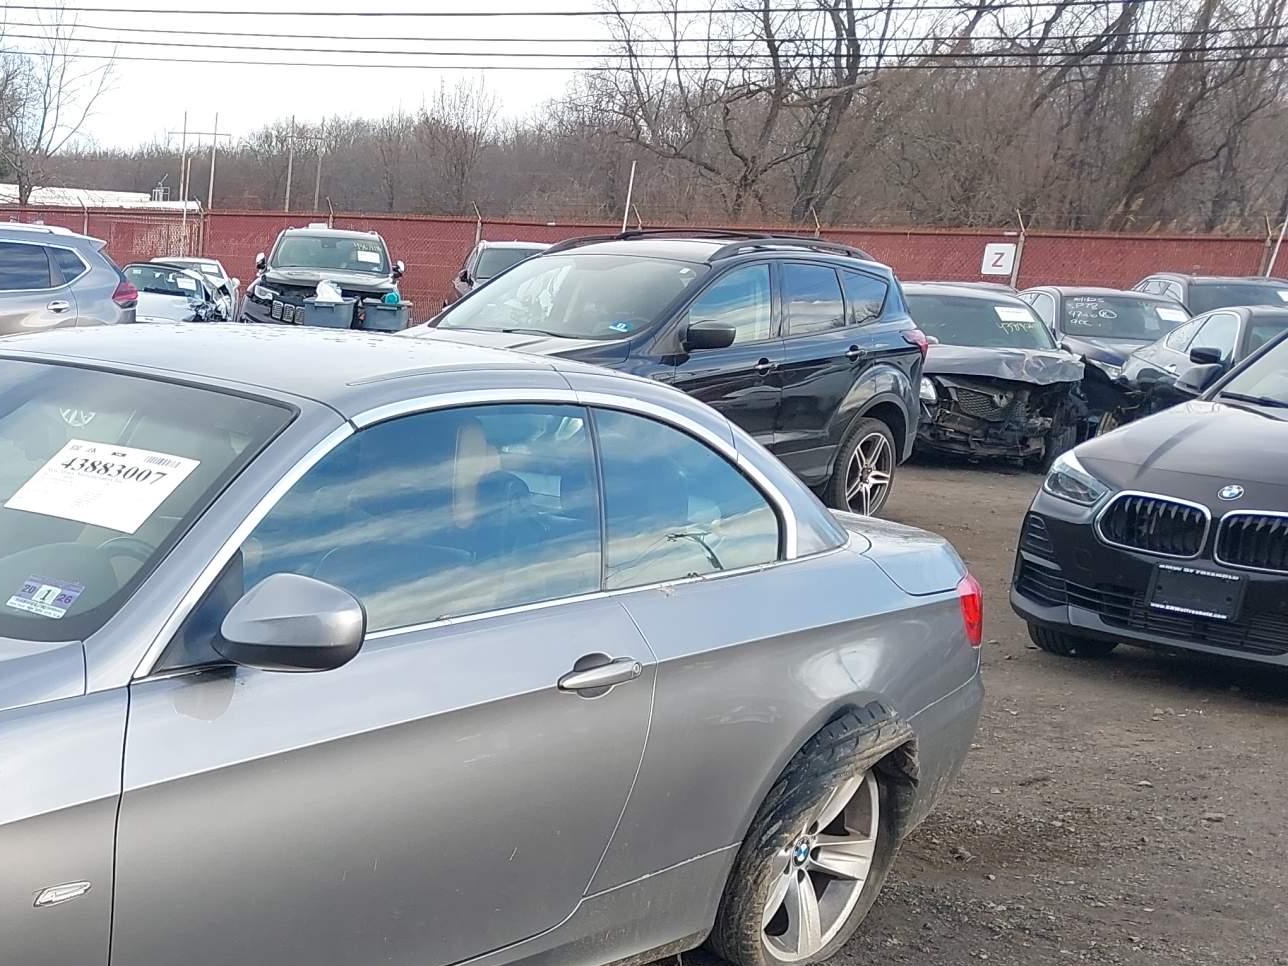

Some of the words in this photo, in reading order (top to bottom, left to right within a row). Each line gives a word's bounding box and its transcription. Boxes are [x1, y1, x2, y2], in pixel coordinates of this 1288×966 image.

[992, 252, 1005, 267] Z
[61, 456, 168, 485] 43883007
[22, 584, 37, 594] 20
[40, 589, 52, 601] 1
[56, 593, 73, 604] 26
